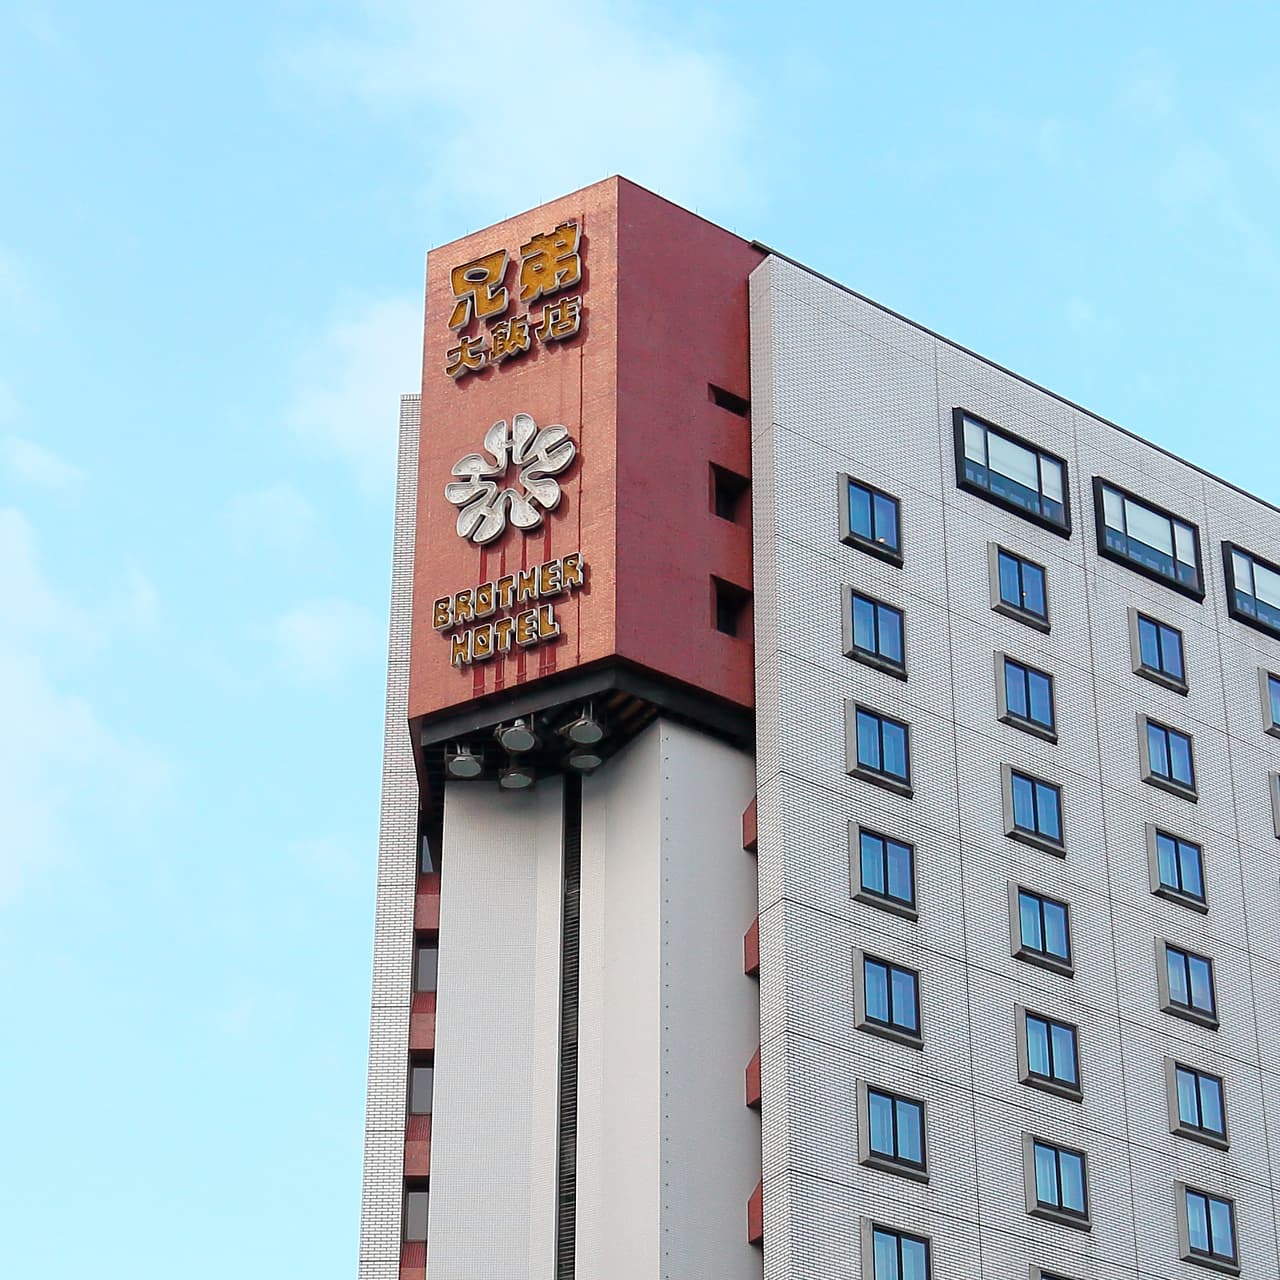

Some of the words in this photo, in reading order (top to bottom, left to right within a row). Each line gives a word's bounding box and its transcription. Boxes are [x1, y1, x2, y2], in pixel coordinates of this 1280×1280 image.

[448, 221, 583, 330] 兄弟
[444, 297, 582, 380] 大飯店
[432, 552, 585, 632] BROTHER
[450, 604, 560, 667] HOTEL
